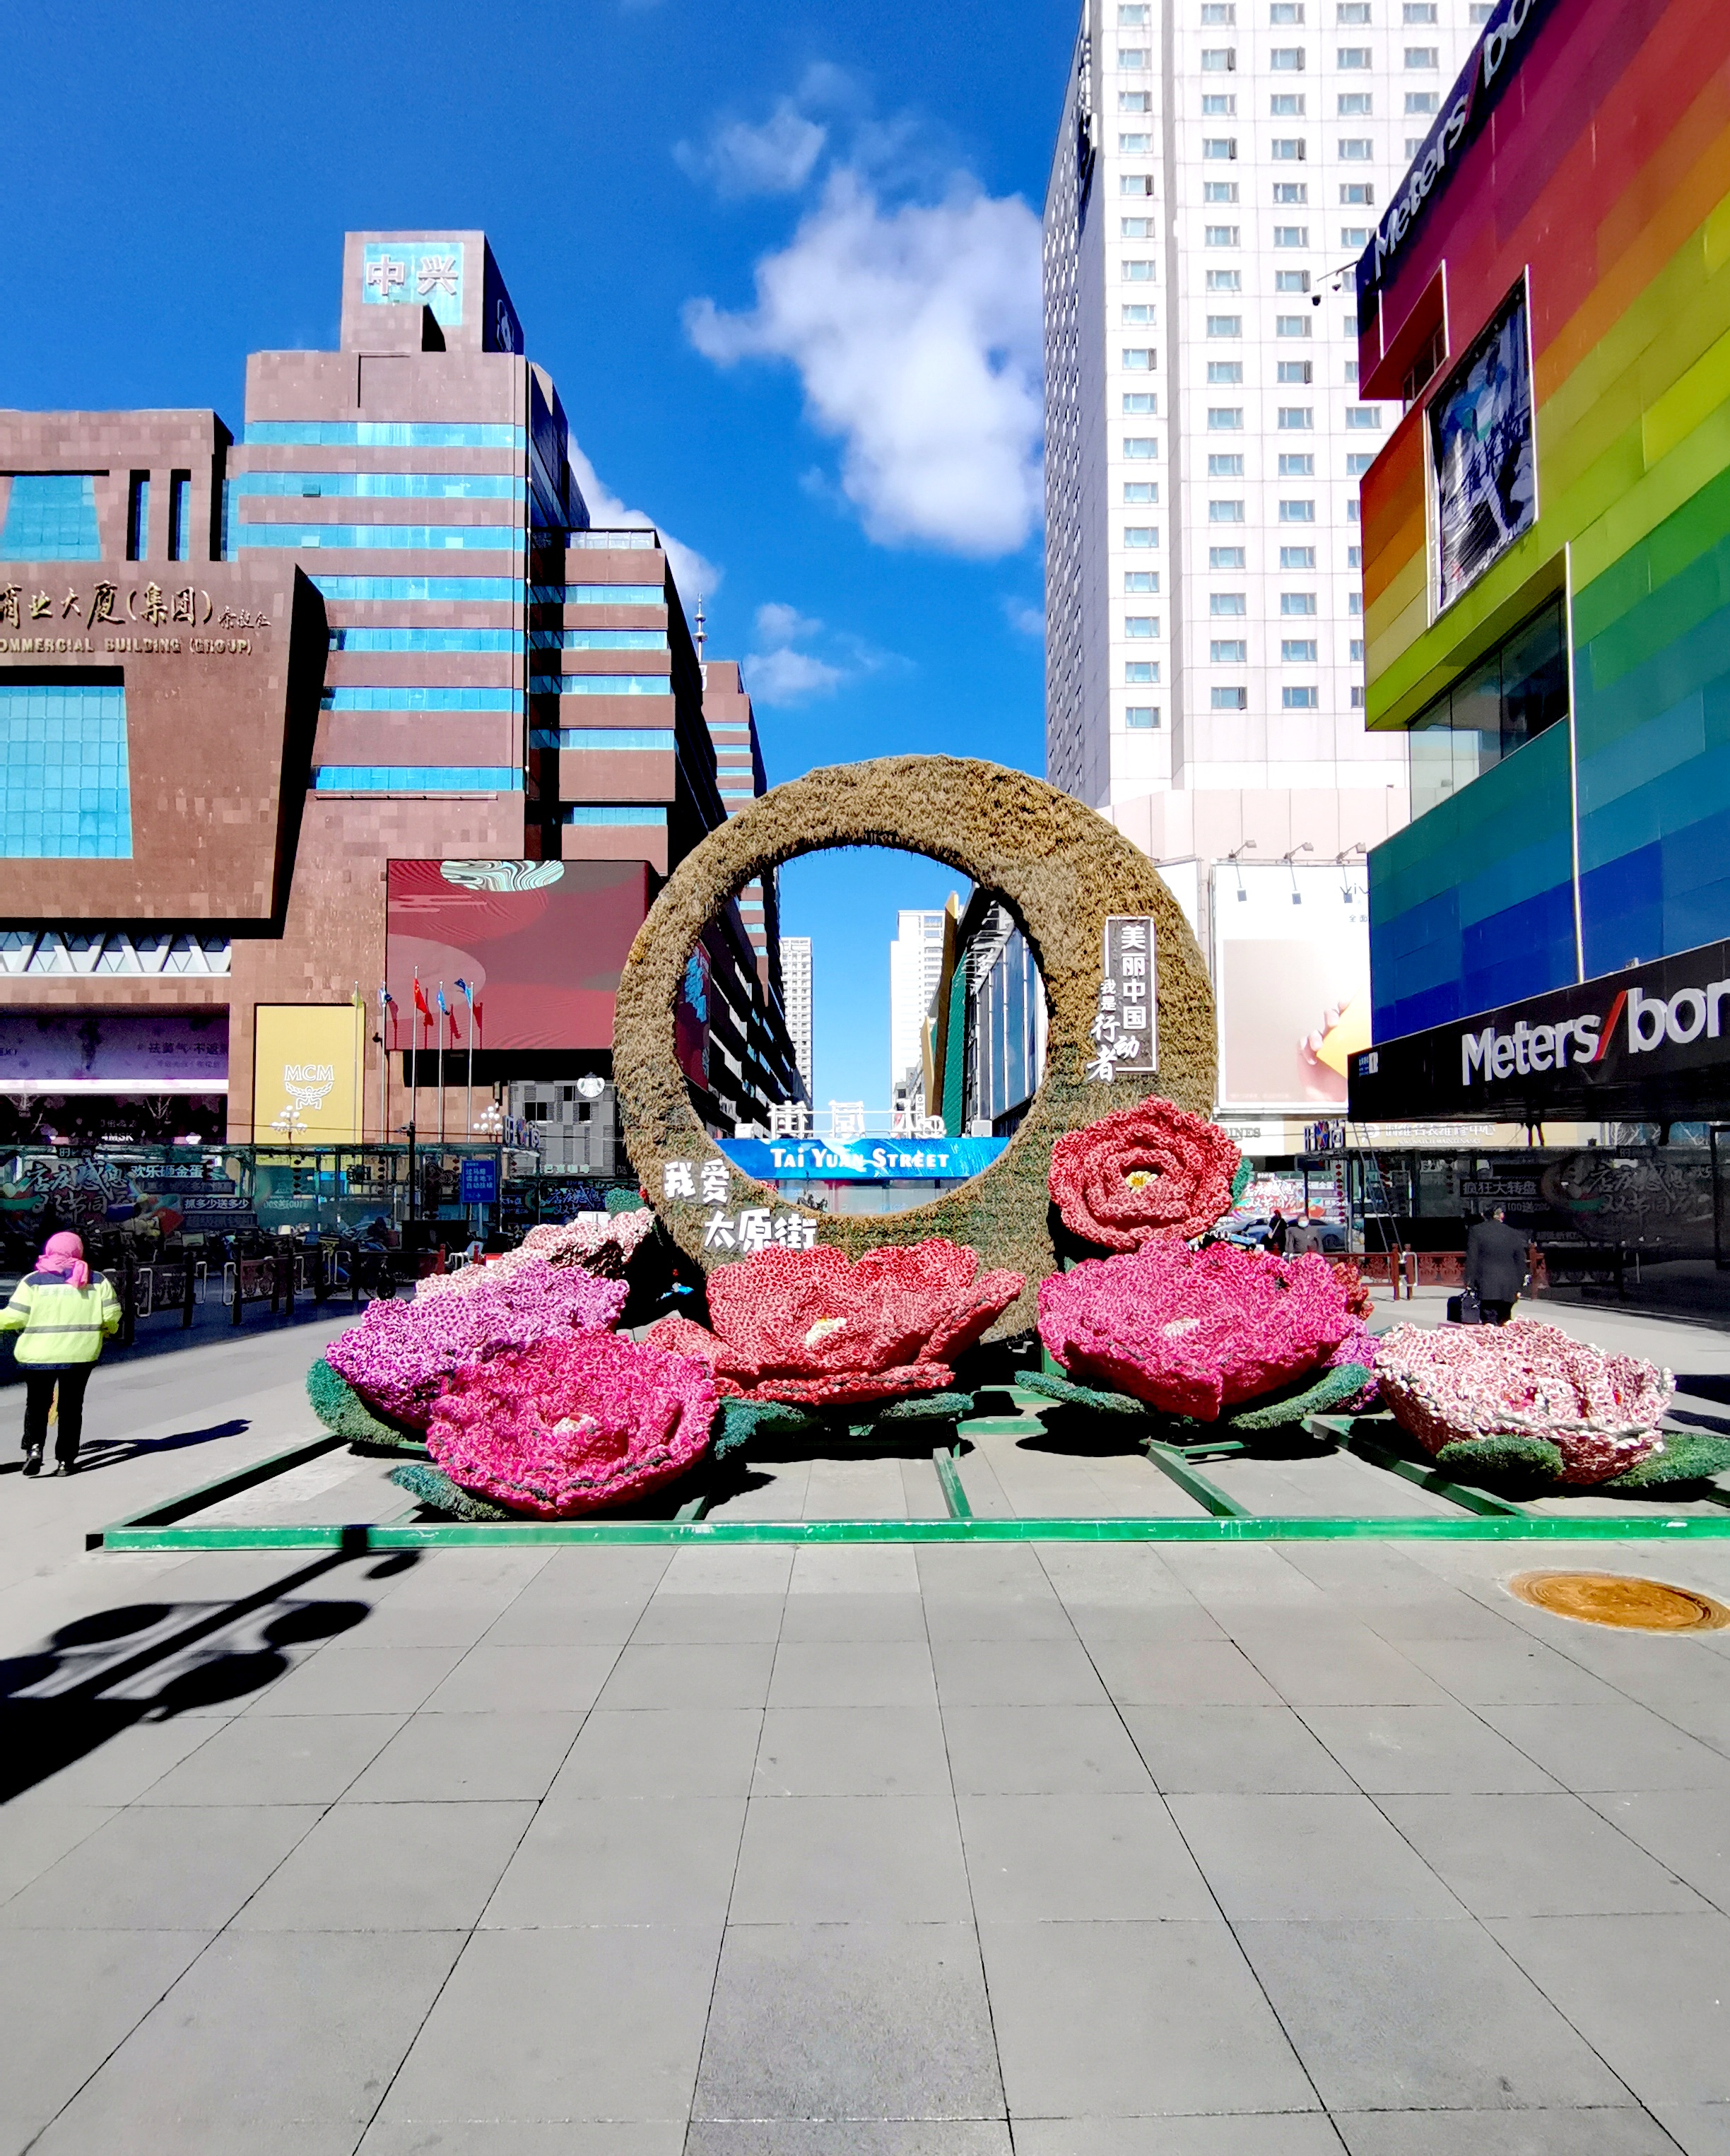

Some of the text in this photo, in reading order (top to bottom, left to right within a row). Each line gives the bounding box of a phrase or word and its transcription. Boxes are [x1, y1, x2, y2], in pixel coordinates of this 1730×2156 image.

[1375, 0, 1535, 281] Meters/bo
[367, 254, 459, 296] 中兴
[106, 638, 182, 654] BUILDING
[189, 639, 252, 655] (GROUP)
[1121, 925, 1146, 1030] 美丽中国
[1086, 979, 1140, 1082] 我是行动者
[284, 1065, 334, 1082] MCM
[664, 1159, 729, 1203] 我爱
[704, 1208, 817, 1252] 太原街
